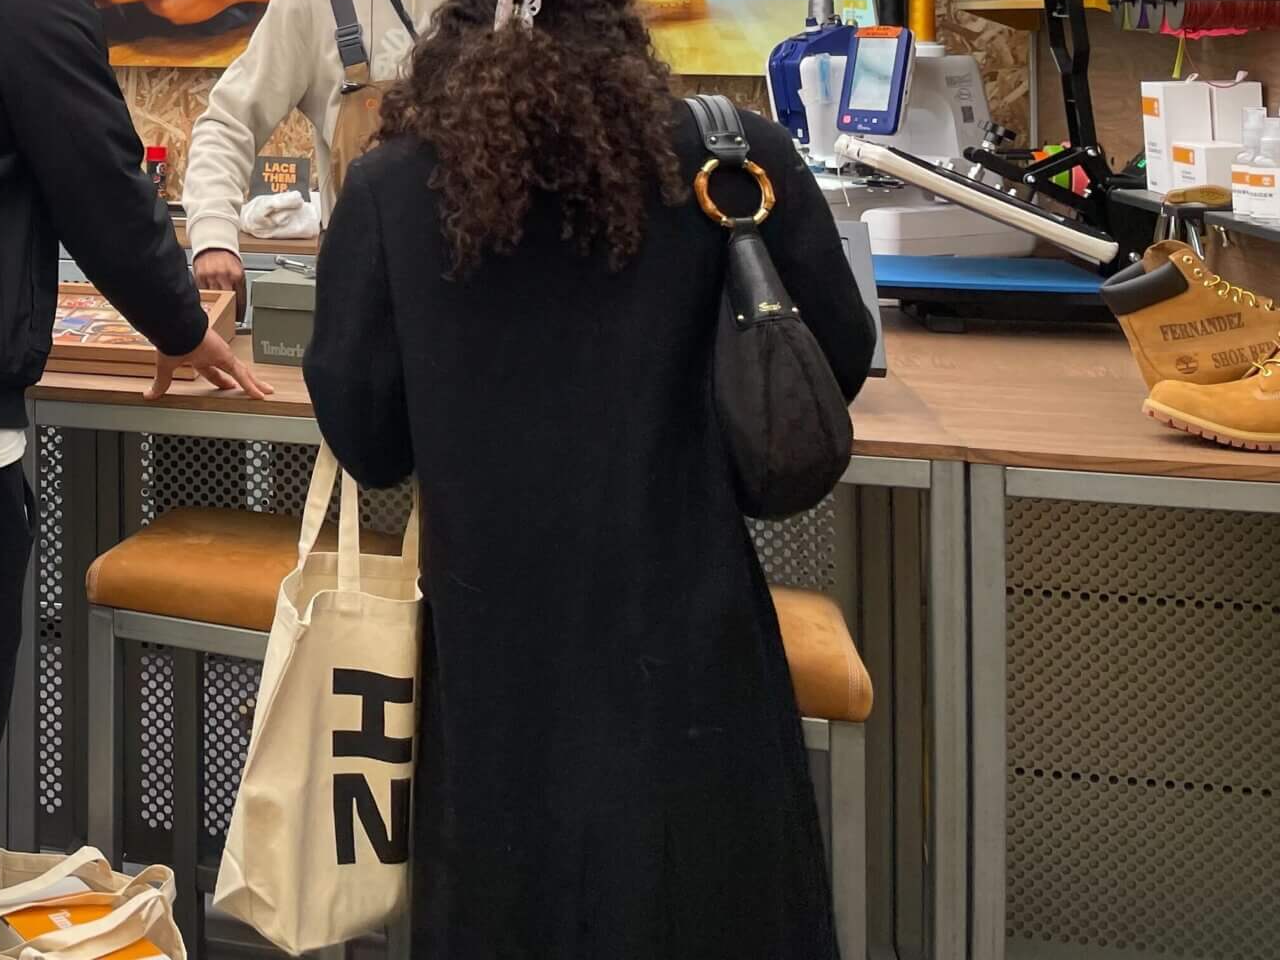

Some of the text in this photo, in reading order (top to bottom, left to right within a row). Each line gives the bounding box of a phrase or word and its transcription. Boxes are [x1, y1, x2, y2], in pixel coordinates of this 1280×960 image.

[264, 161, 297, 173] LACE
[261, 172, 297, 184] THEM
[1160, 312, 1245, 341] FERNANDEZ
[1212, 348, 1249, 369] SHOE
